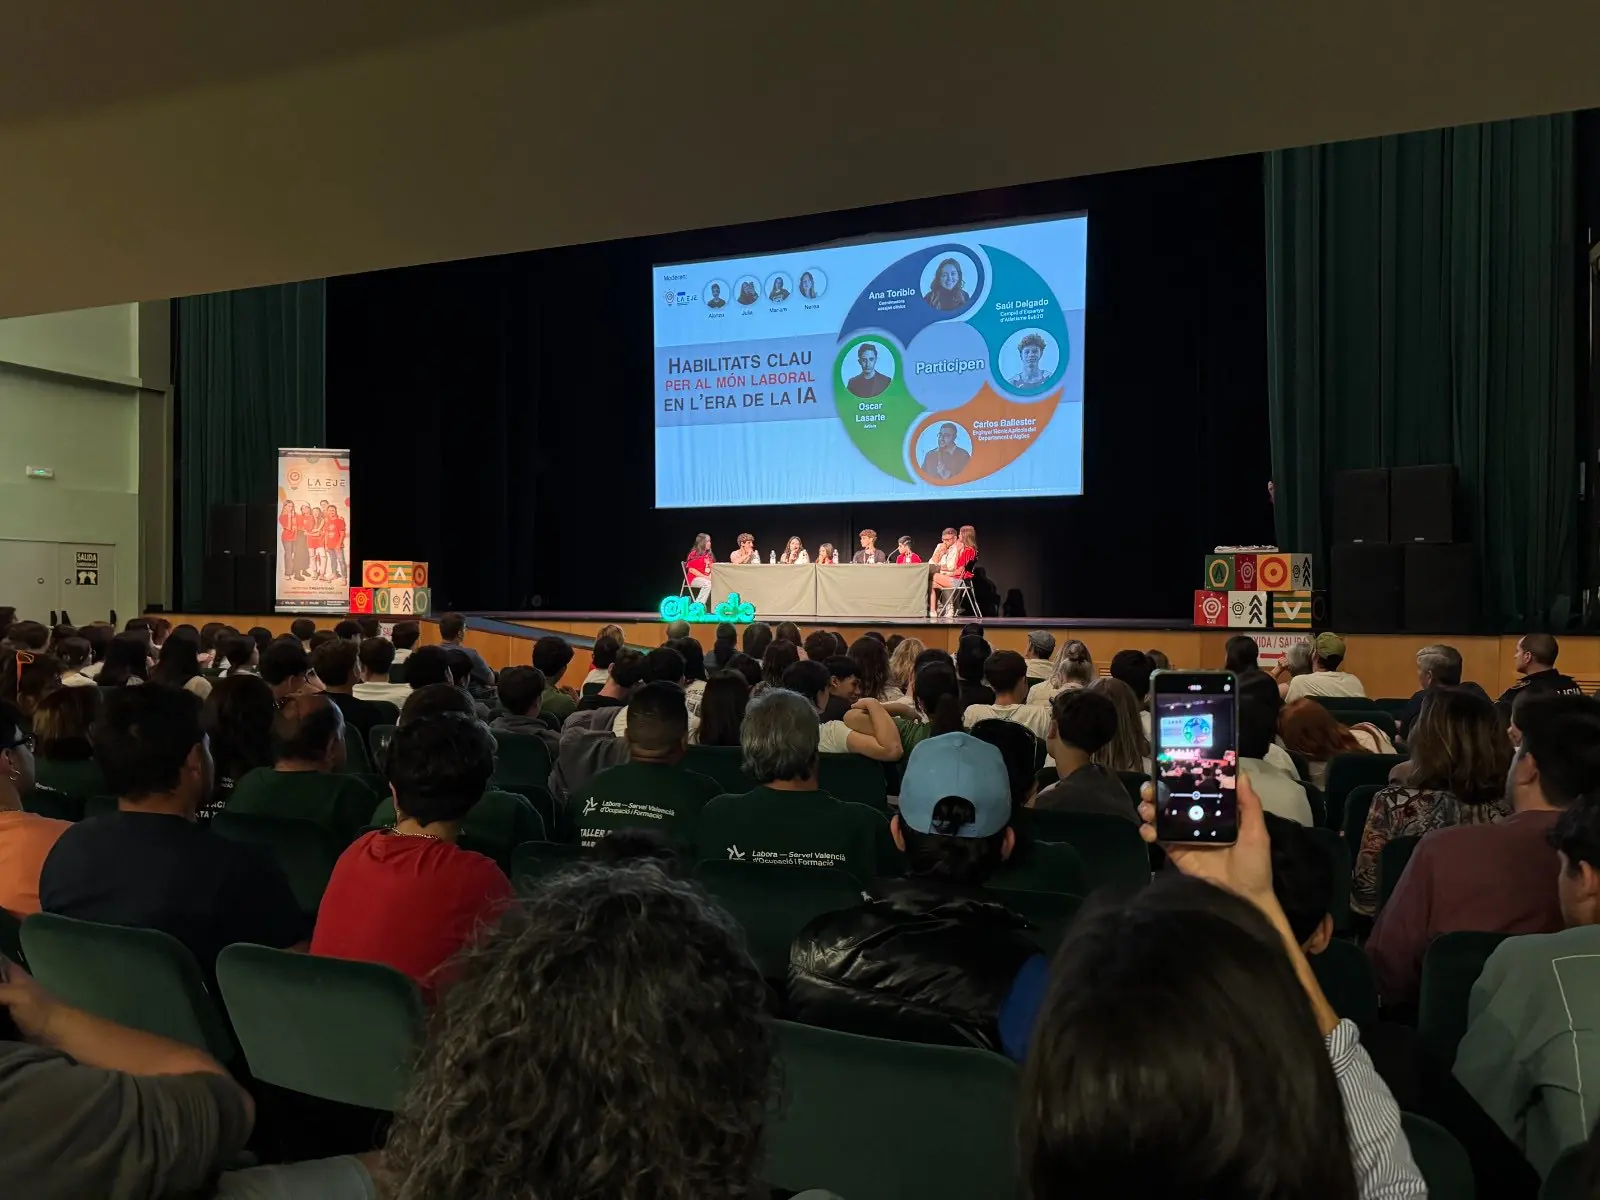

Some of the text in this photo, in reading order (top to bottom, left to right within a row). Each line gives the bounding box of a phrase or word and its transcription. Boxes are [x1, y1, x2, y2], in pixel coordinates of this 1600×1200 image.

[868, 287, 916, 300] Ana Toribio
[995, 297, 1049, 311] Saúl Delgado
[767, 351, 812, 368] CLAU
[915, 358, 985, 375] Participen
[665, 370, 816, 392] PER AL MÓN LABORAL
[664, 386, 817, 412] EN L'ERA DE LA IA
[858, 402, 883, 411] Oscar
[855, 413, 886, 423] Lasarte
[973, 417, 1037, 429] Carlos Ballester
[307, 477, 346, 488] LA EJE
[77, 553, 97, 561] SALIDA
[602, 800, 621, 808] Labora
[628, 802, 648, 810] Servei
[648, 804, 675, 817] Valencià
[633, 810, 663, 819] Formació
[580, 828, 606, 838] TALLER
[752, 850, 778, 858] Labora
[788, 851, 813, 859] Servei
[814, 852, 846, 862] Valencià
[797, 858, 834, 867] Formació
